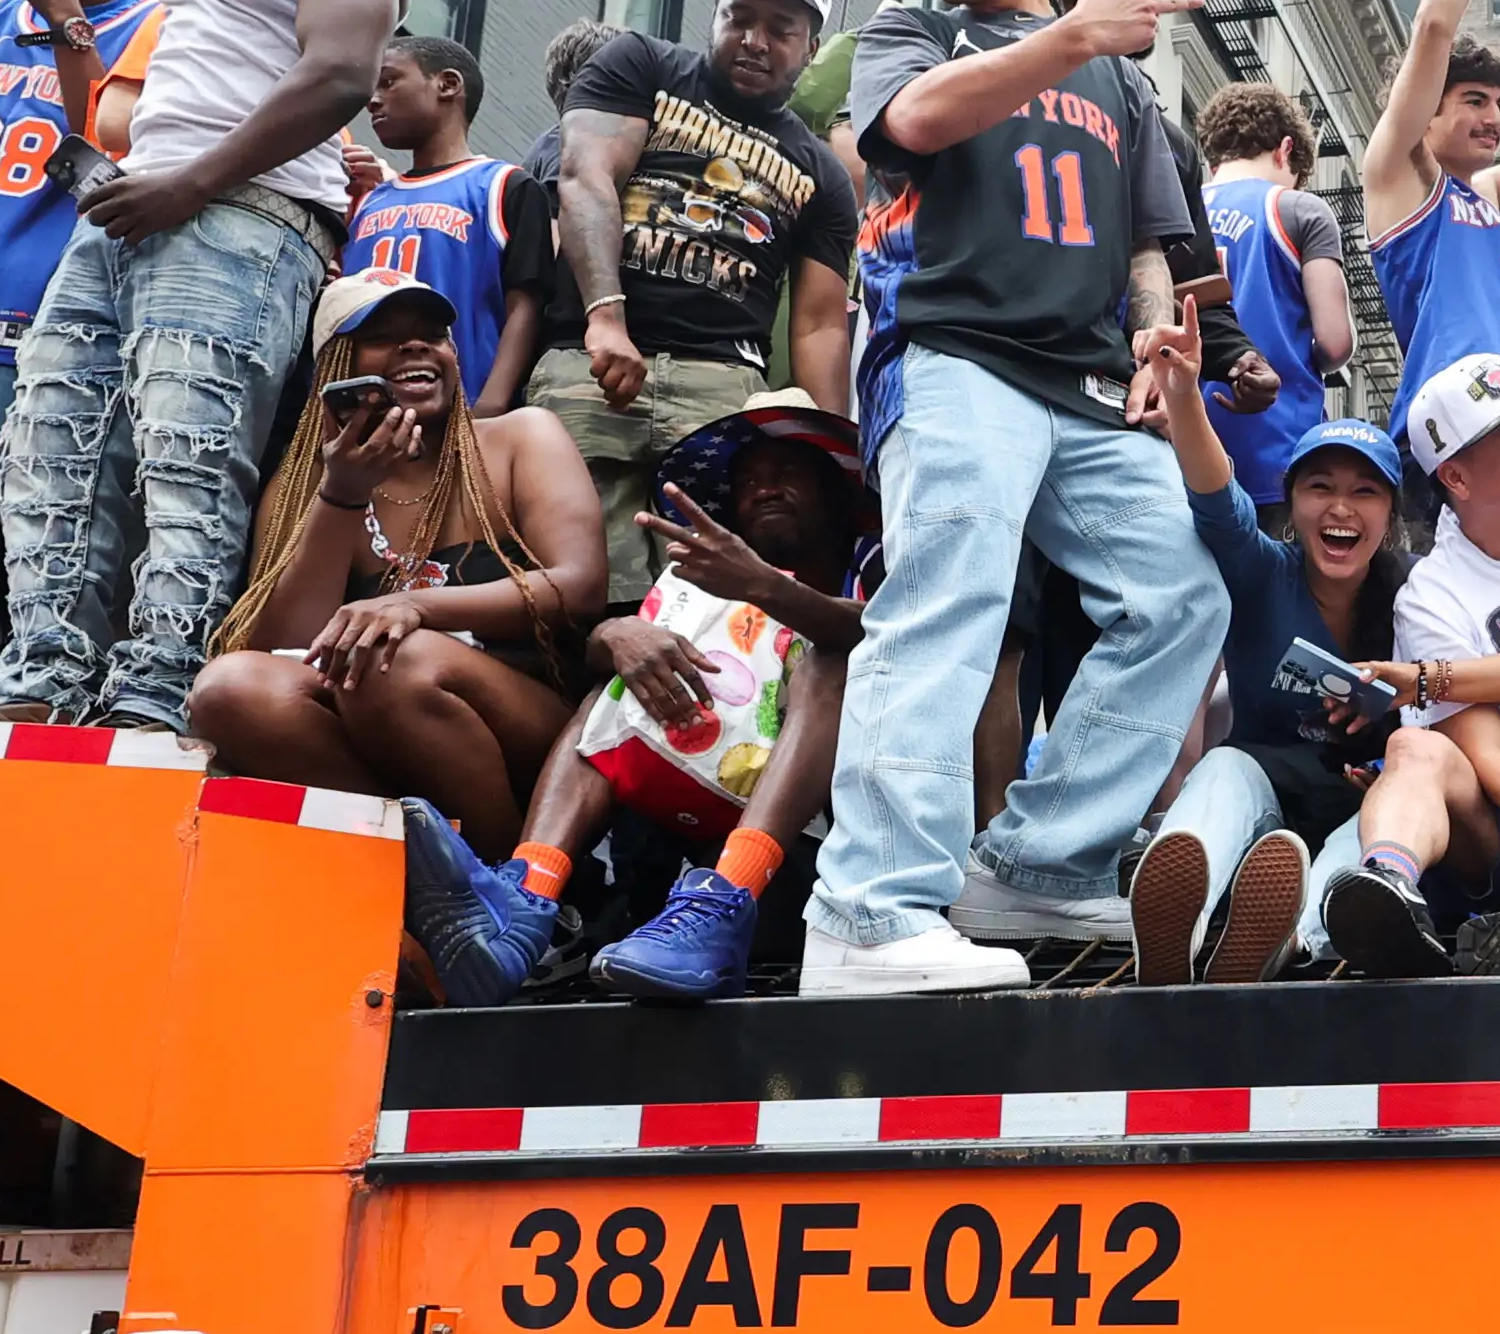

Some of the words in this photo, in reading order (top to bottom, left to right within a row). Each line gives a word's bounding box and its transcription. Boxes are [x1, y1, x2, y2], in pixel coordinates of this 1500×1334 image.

[19, 65, 65, 107] YO
[1038, 89, 1121, 169] YORK
[403, 203, 474, 243] YORK
[1014, 143, 1095, 246] 11
[372, 235, 422, 278] 11
[501, 1201, 1182, 1329] 38AF-042
